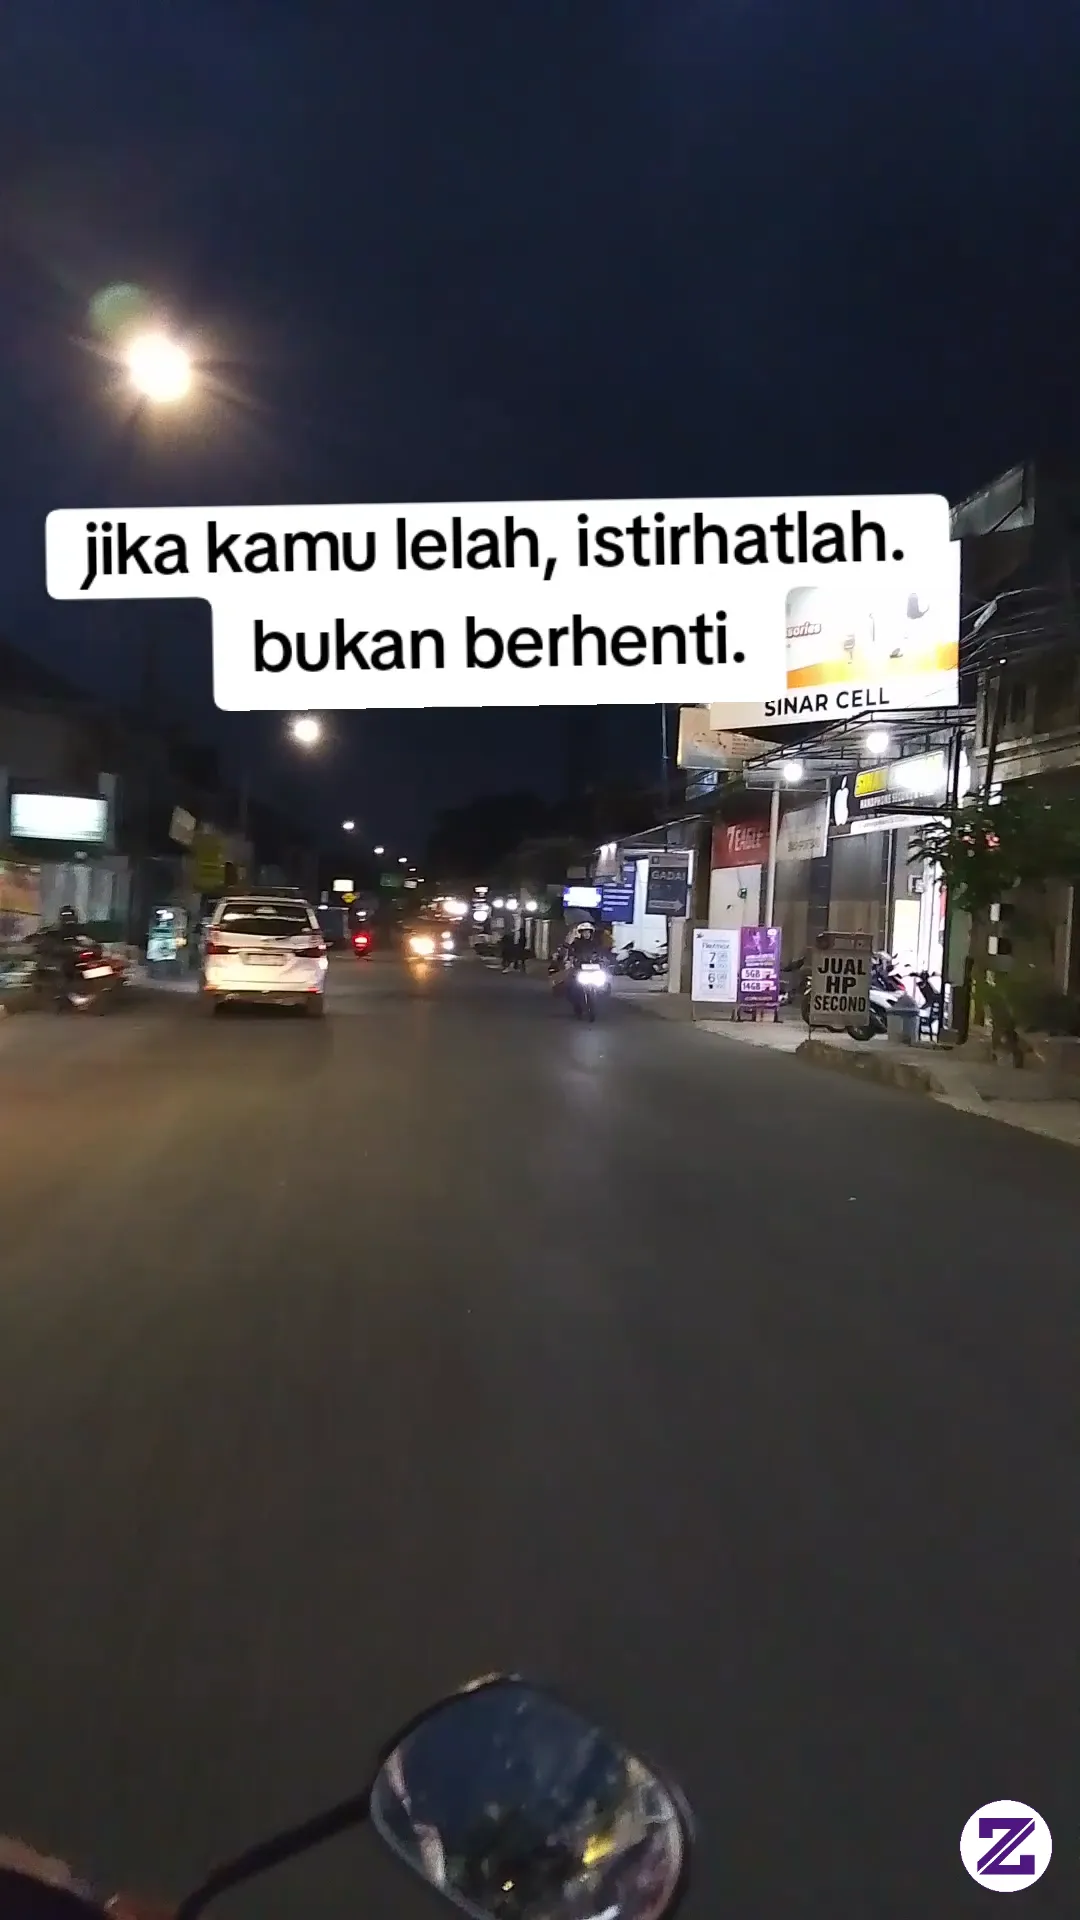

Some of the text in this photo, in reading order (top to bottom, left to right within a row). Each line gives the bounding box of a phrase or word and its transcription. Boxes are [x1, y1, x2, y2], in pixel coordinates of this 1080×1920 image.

[764, 687, 890, 717] SINAR CELL
[651, 870, 686, 881] GADAI
[745, 969, 761, 978] 5GB
[817, 957, 867, 975] JUAL
[742, 982, 761, 991] 14GB
[826, 976, 857, 994] HP
[814, 995, 867, 1012] SECOND
